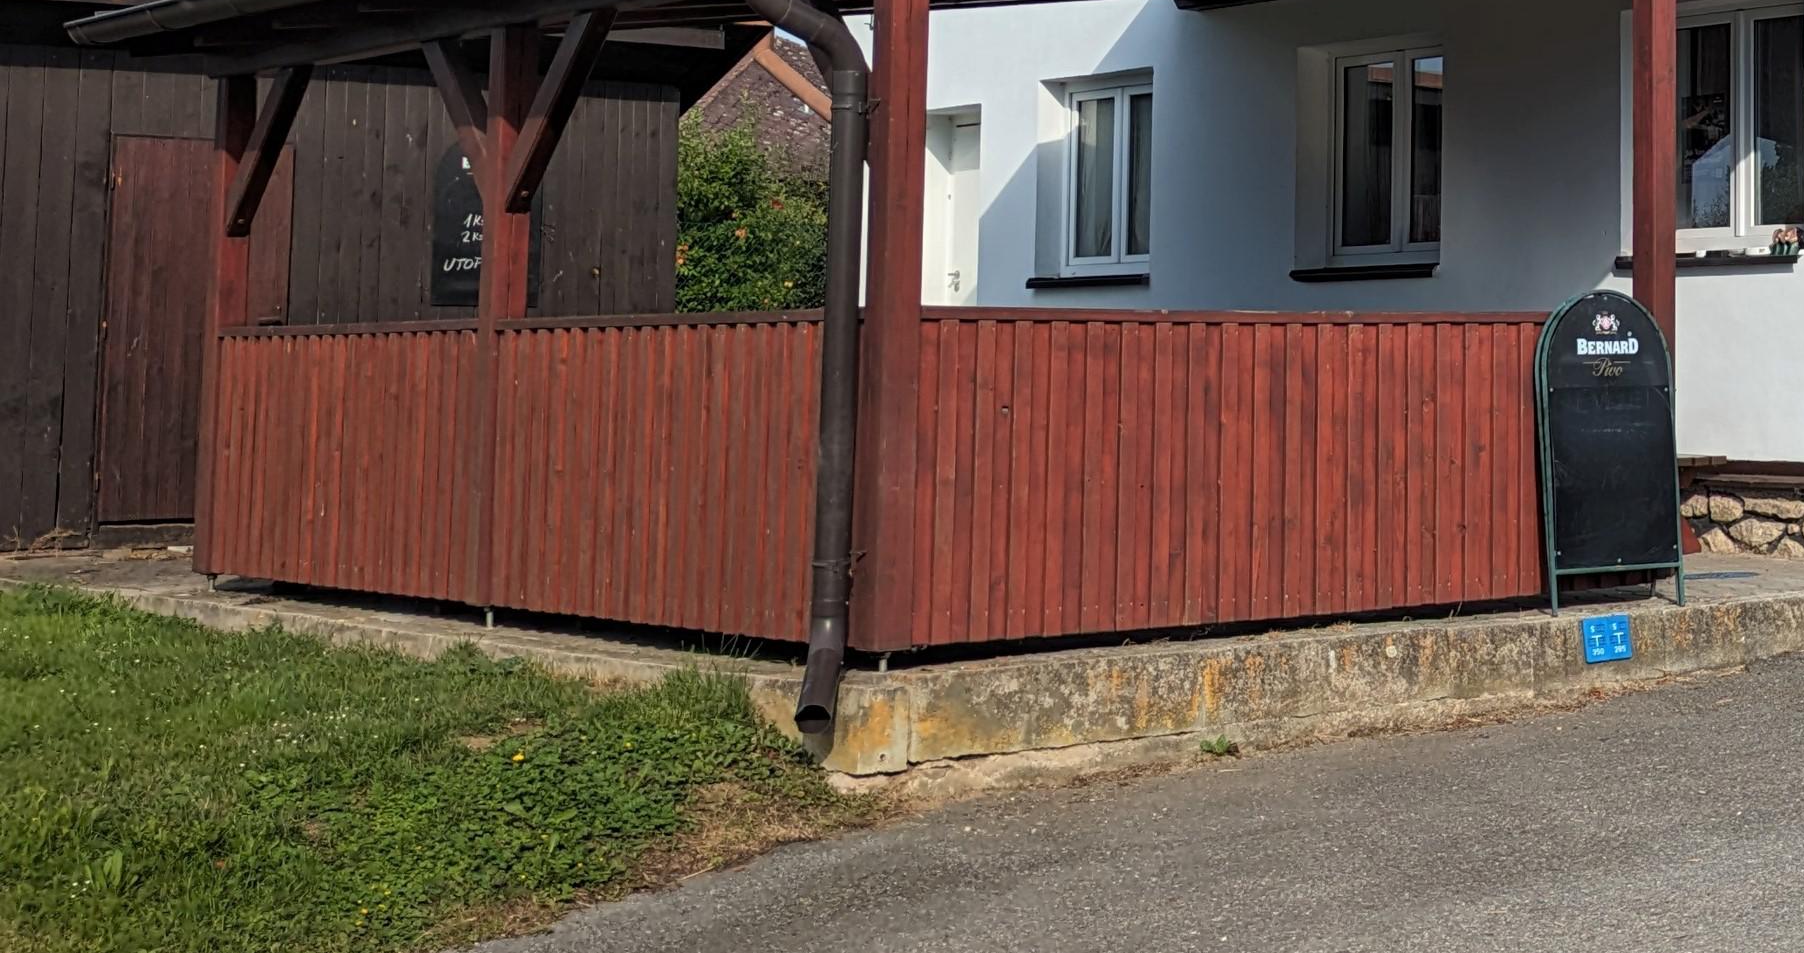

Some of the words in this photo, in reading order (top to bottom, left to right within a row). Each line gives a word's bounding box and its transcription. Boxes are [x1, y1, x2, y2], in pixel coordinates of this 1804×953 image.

[463, 213, 473, 228] 1
[461, 231, 470, 243] 2
[1576, 337, 1639, 355] BERNARD
[1592, 357, 1623, 377] Pivo
[1591, 634, 1603, 647] T
[1613, 632, 1624, 644] T
